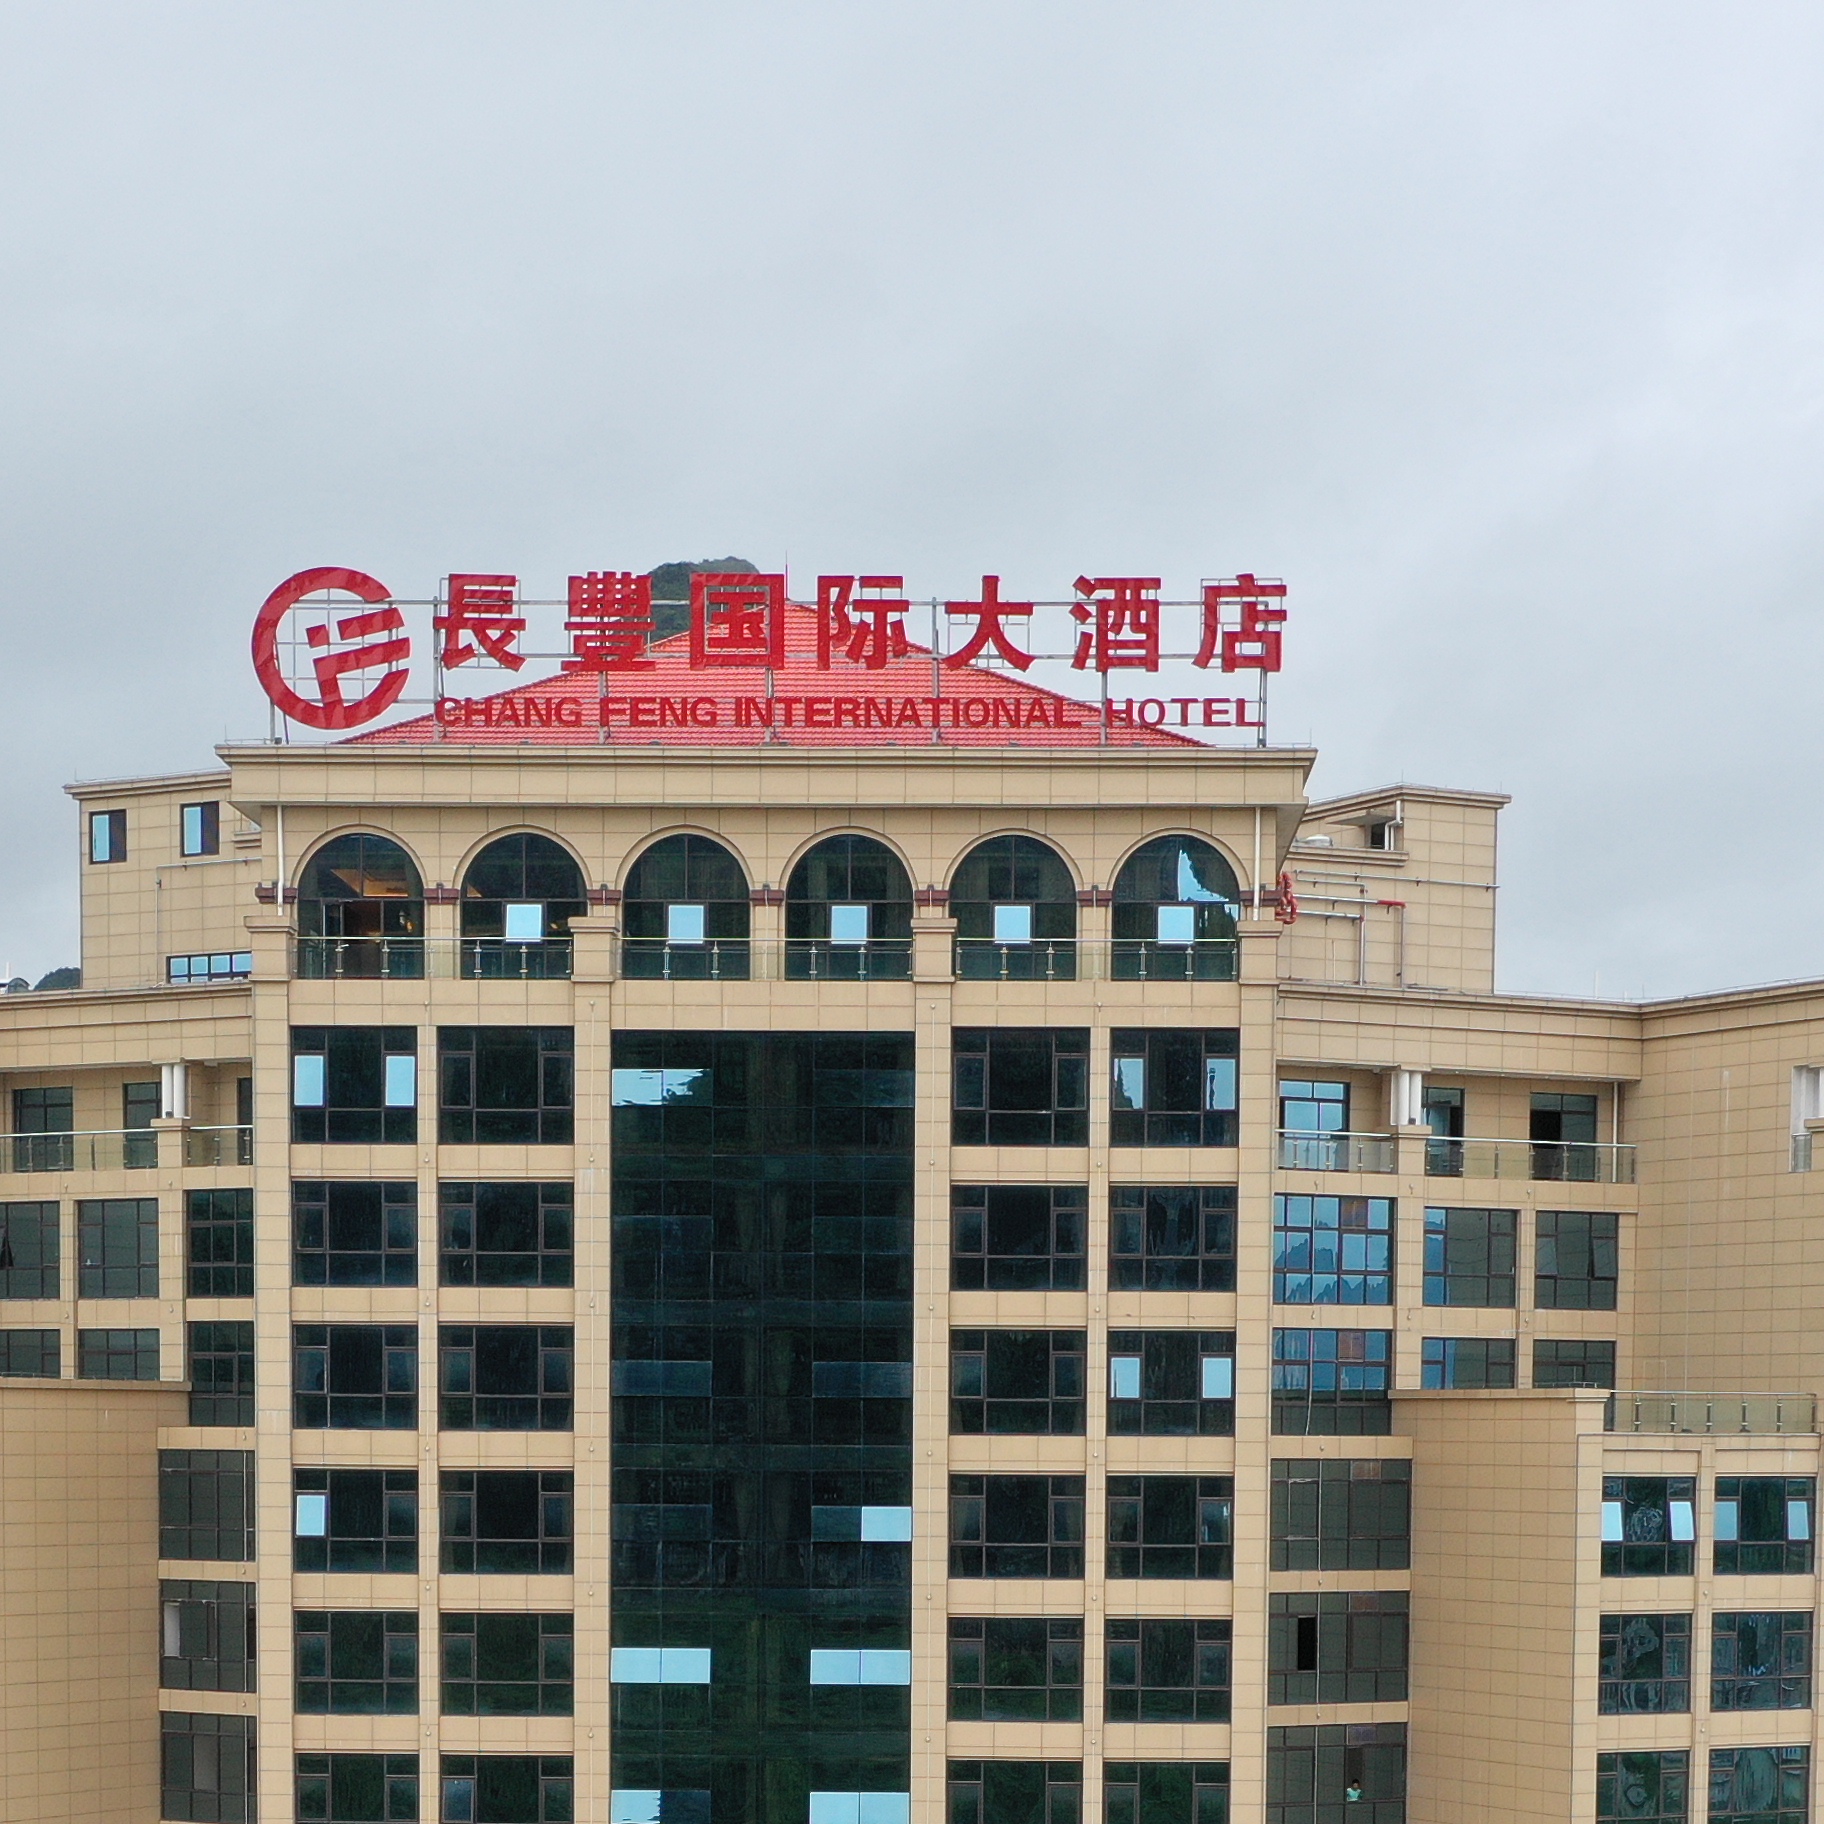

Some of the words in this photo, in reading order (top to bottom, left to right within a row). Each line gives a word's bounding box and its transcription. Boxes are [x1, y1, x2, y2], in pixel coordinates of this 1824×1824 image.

[433, 571, 1287, 672] 長豐国际大酒店
[435, 696, 583, 728] CHANG
[600, 696, 719, 728] FENG
[734, 696, 1082, 728] INTERNATIONAL
[1105, 696, 1265, 728] HOTEL
